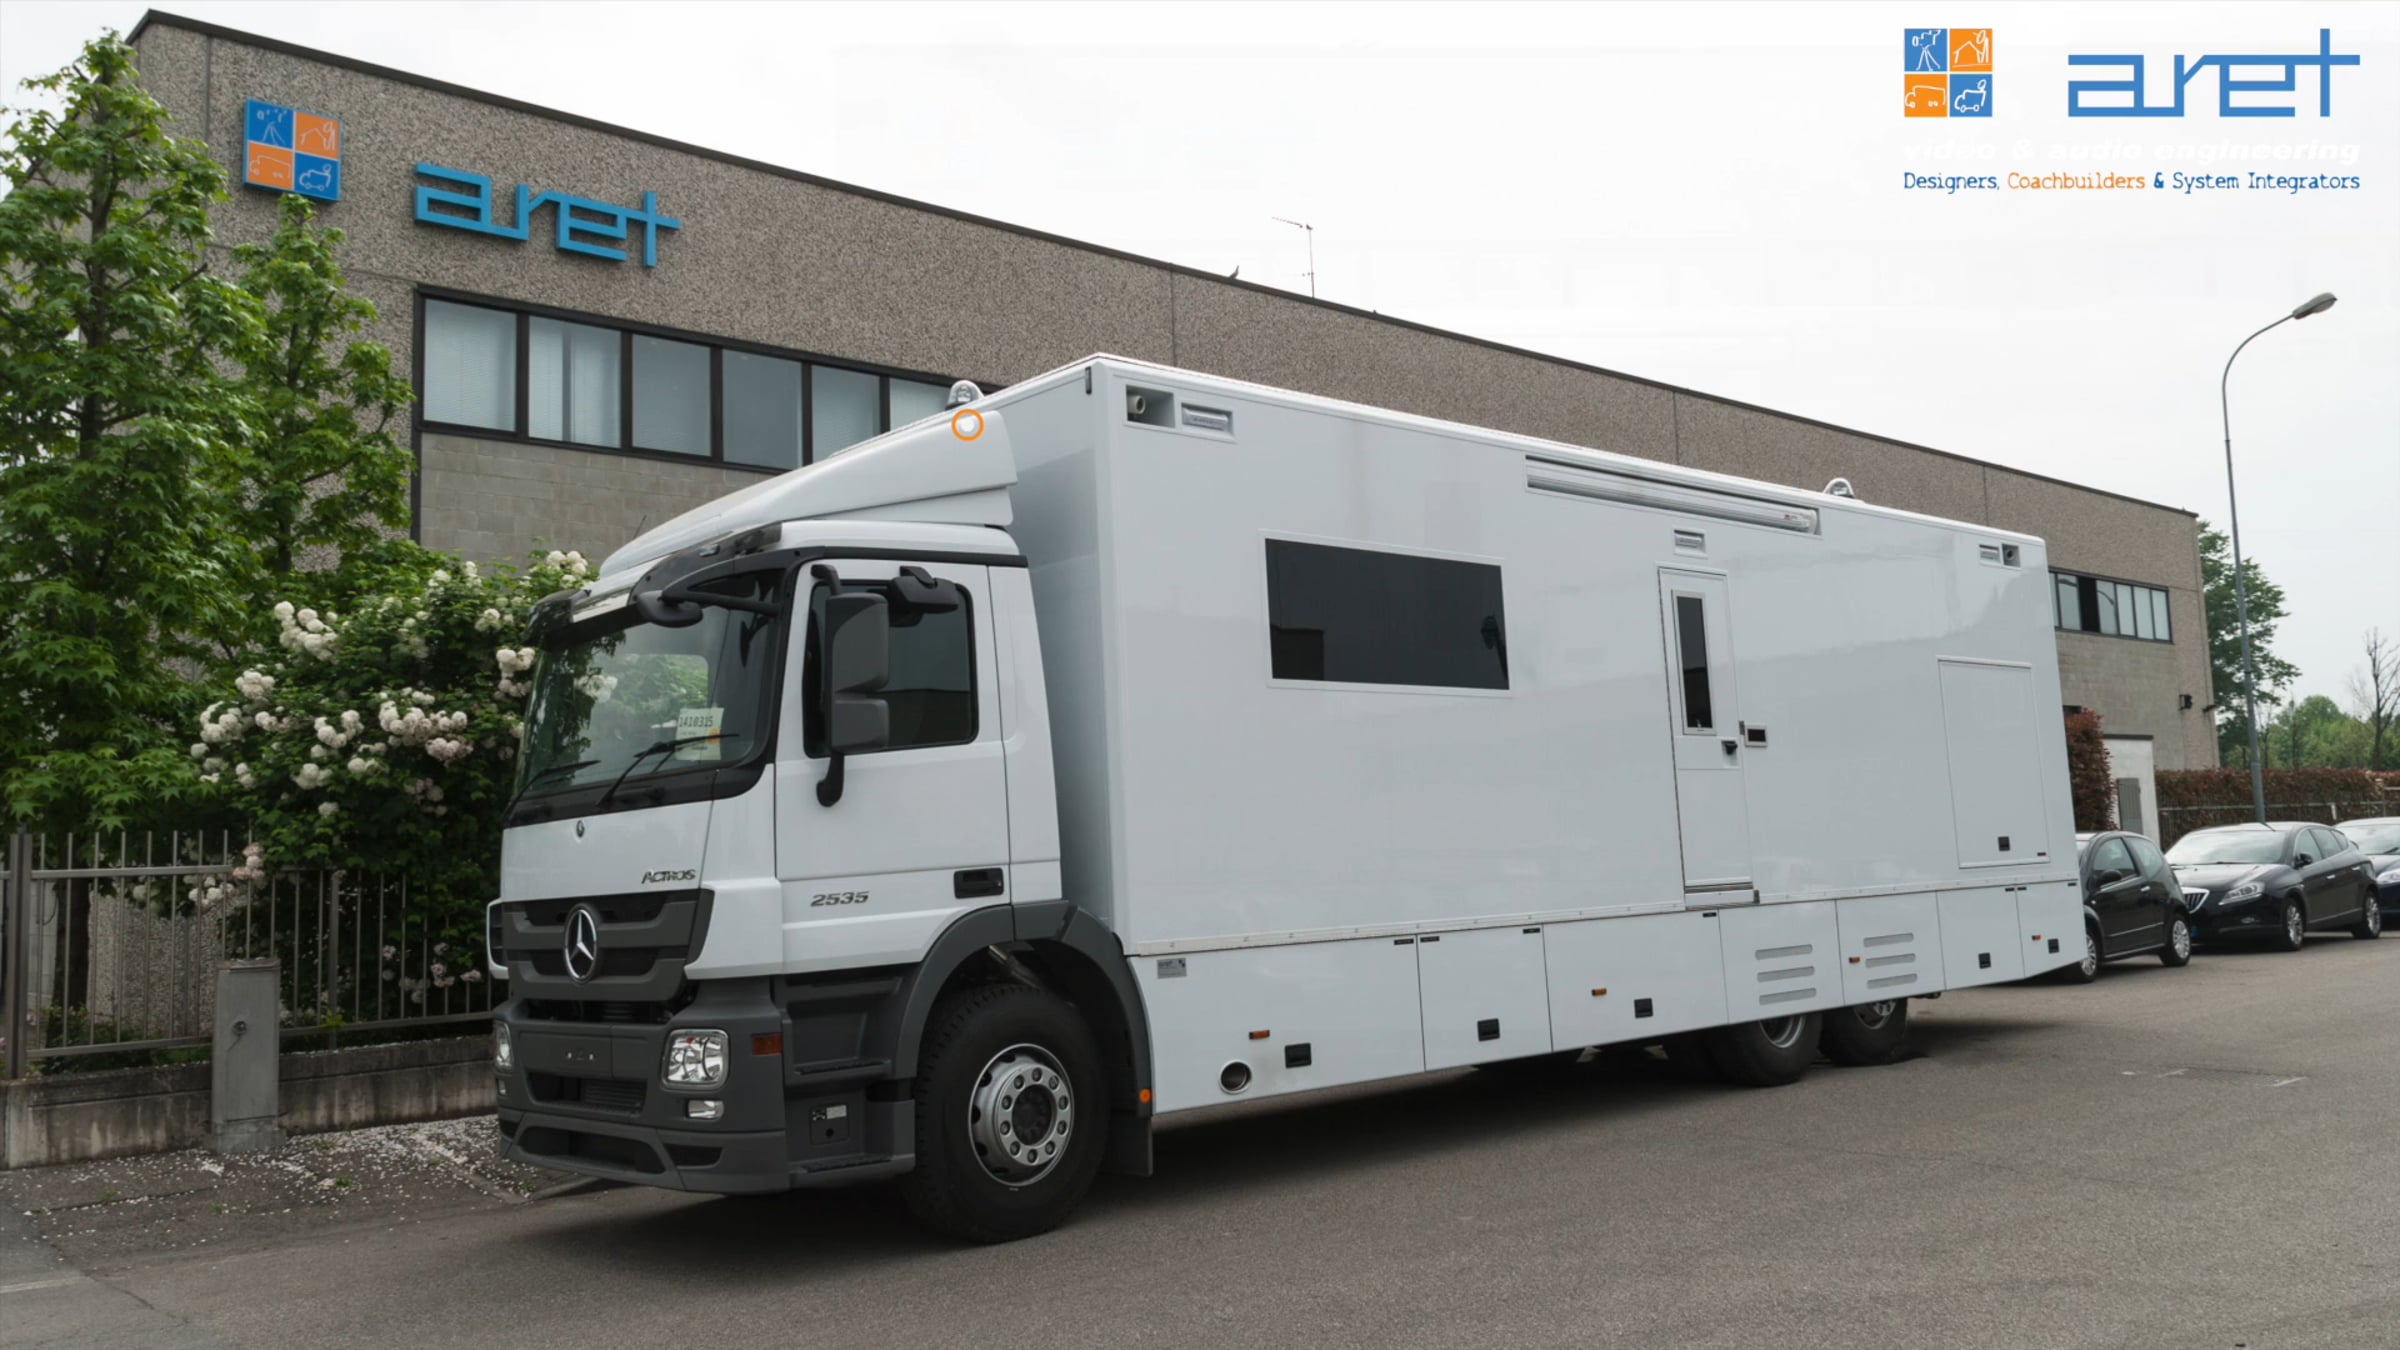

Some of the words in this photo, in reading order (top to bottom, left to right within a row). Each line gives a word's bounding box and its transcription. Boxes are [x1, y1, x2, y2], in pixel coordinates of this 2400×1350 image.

[415, 163, 681, 267] aret
[641, 869, 696, 884] ACTROS
[810, 891, 869, 907] 2535
